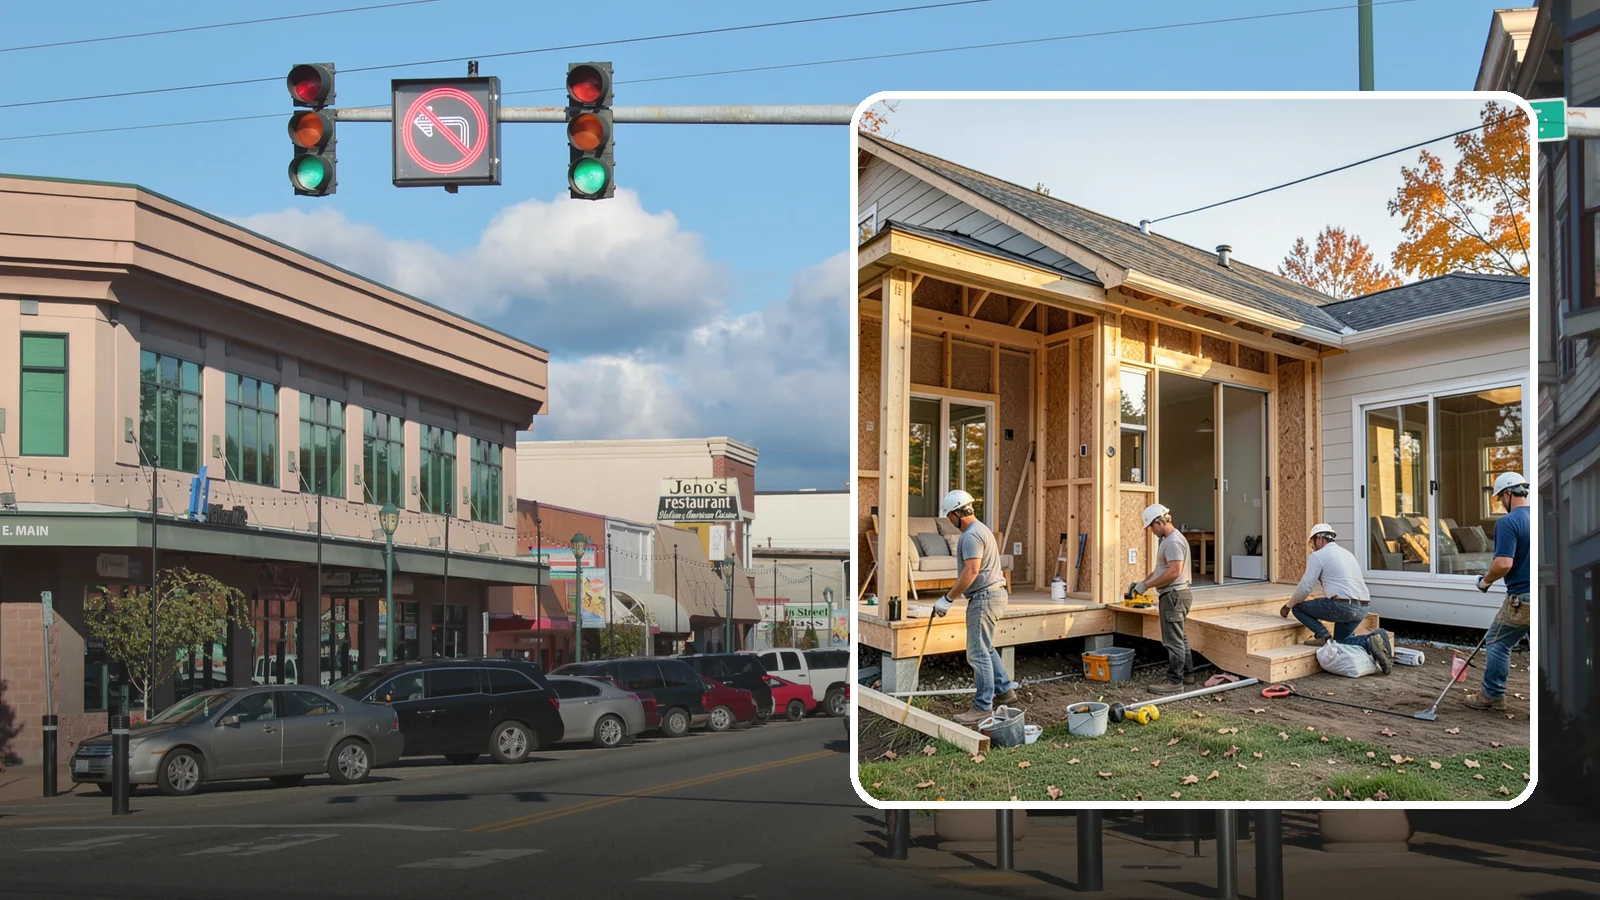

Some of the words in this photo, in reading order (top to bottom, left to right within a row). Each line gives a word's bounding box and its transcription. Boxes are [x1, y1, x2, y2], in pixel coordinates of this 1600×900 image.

[670, 480, 728, 495] Jeno's
[665, 496, 731, 509] restaurant
[658, 509, 681, 520] Italian
[686, 509, 714, 520] American
[715, 509, 738, 519] Cuisine
[2, 525, 13, 536] E.
[15, 525, 49, 536] MAIN
[797, 607, 828, 617] Street
